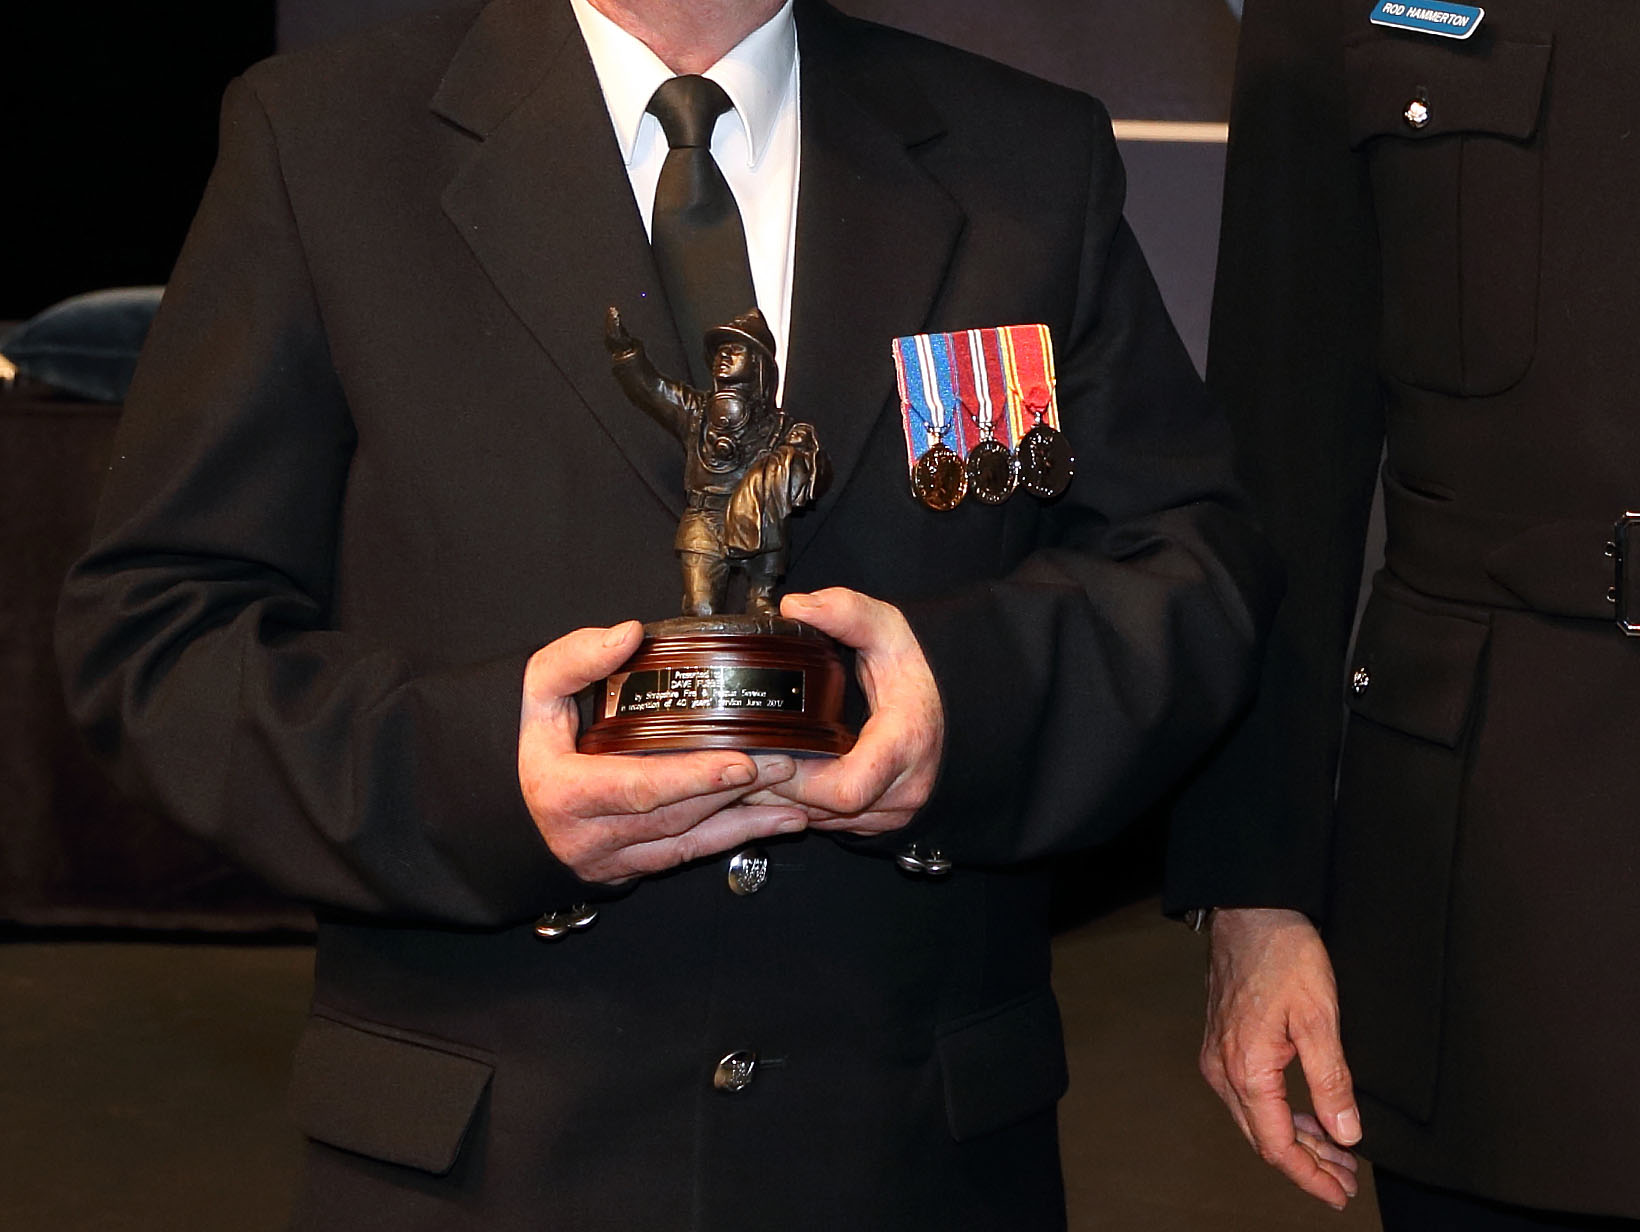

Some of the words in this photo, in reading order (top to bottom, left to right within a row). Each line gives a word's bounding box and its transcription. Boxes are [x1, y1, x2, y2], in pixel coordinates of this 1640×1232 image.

[1382, 2, 1405, 16] ROD
[1406, 6, 1470, 27] HAMMERTON
[671, 679, 692, 689] DAVE
